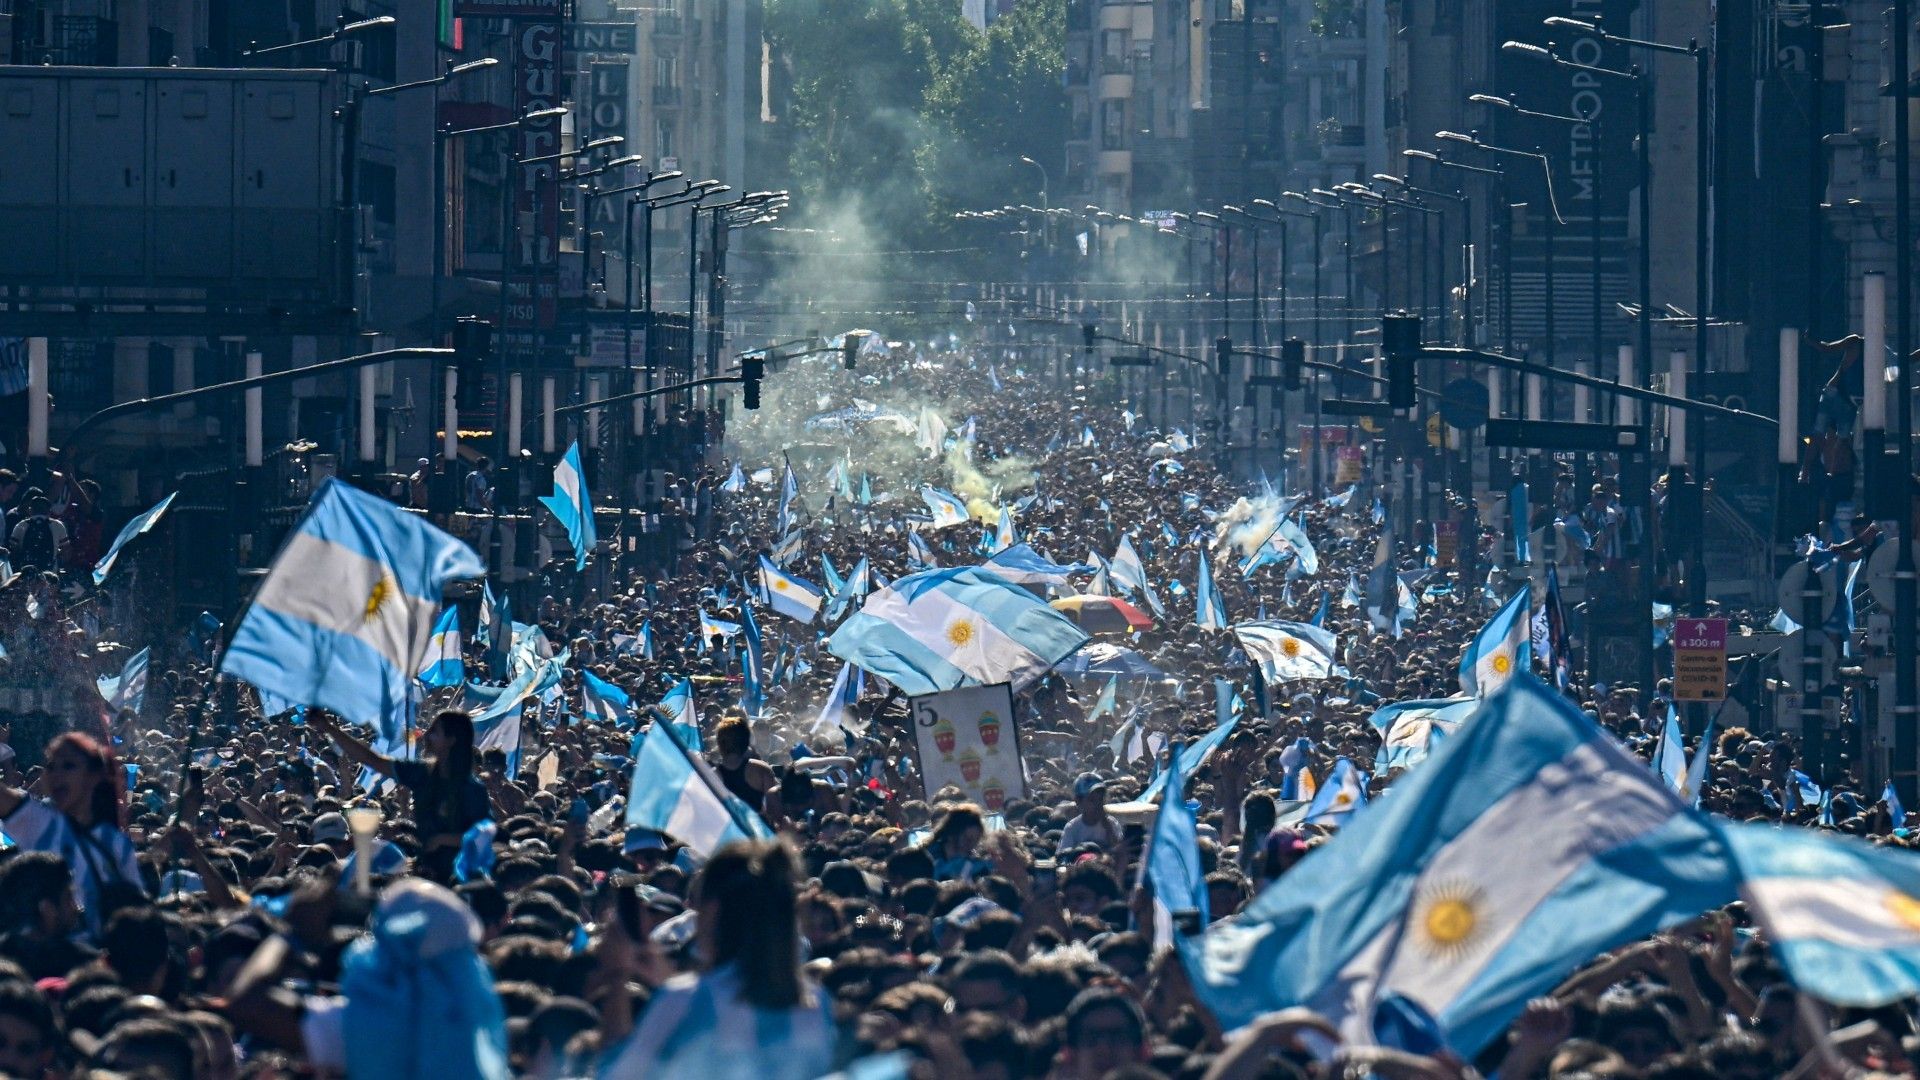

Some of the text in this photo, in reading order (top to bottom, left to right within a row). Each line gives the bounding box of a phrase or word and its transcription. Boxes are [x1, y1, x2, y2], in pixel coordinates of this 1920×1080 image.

[562, 27, 634, 49] INE
[1689, 639, 1708, 647] 300
[917, 701, 938, 727] 5
